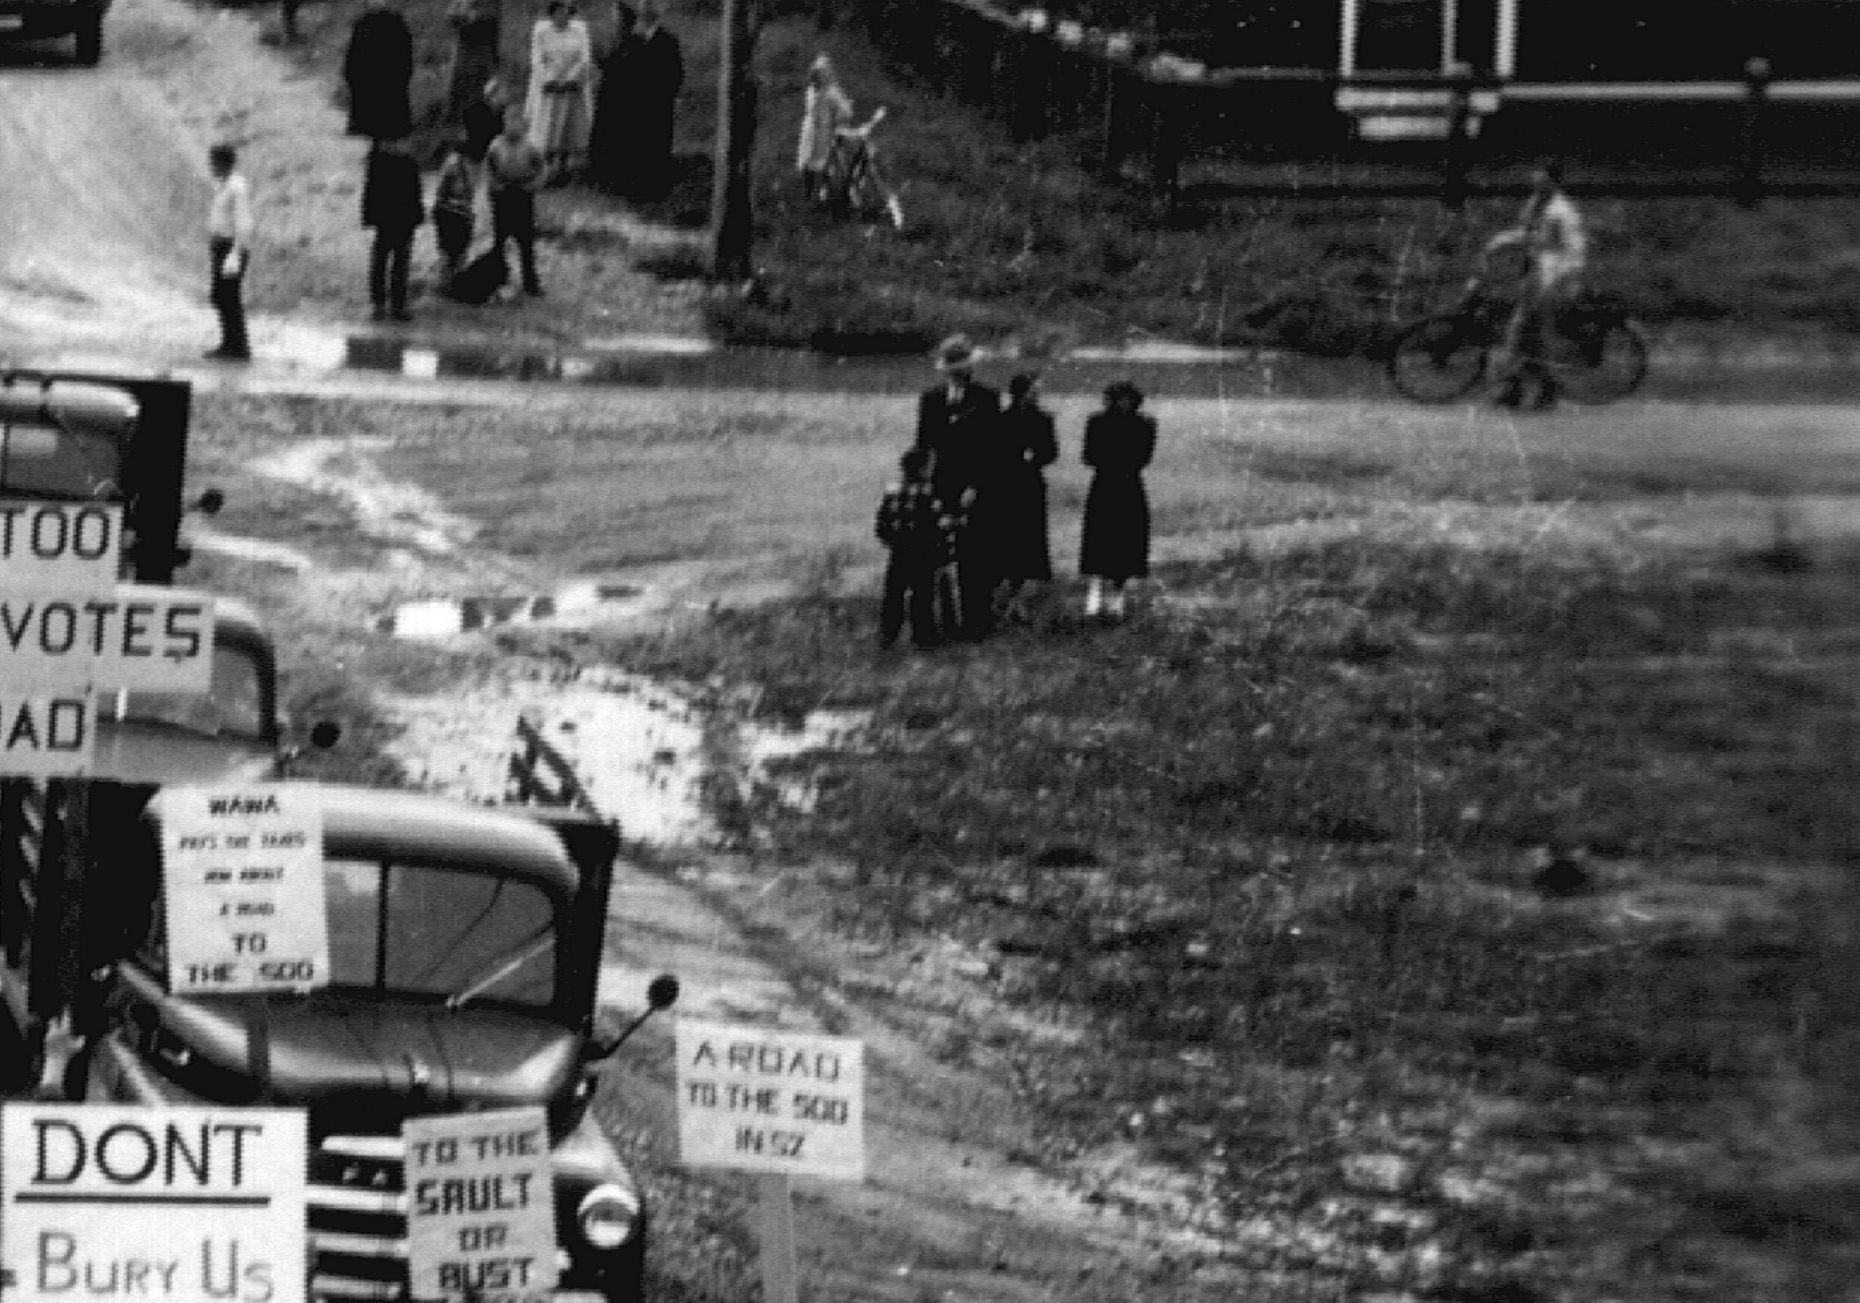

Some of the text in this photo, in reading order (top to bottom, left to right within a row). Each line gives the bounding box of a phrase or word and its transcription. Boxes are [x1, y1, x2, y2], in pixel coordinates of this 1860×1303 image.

[0, 601, 203, 659] VOTES
[208, 795, 280, 816] WAWA
[232, 931, 268, 953] TO
[184, 962, 236, 984] THE
[693, 1041, 839, 1082] A ROAD
[686, 1079, 849, 1125] TO THE SOO
[31, 1118, 264, 1186] DONT
[411, 1127, 541, 1166] TO THE
[414, 1172, 532, 1216] SAULT
[460, 1223, 507, 1251] OR
[438, 1257, 535, 1291] BUST
